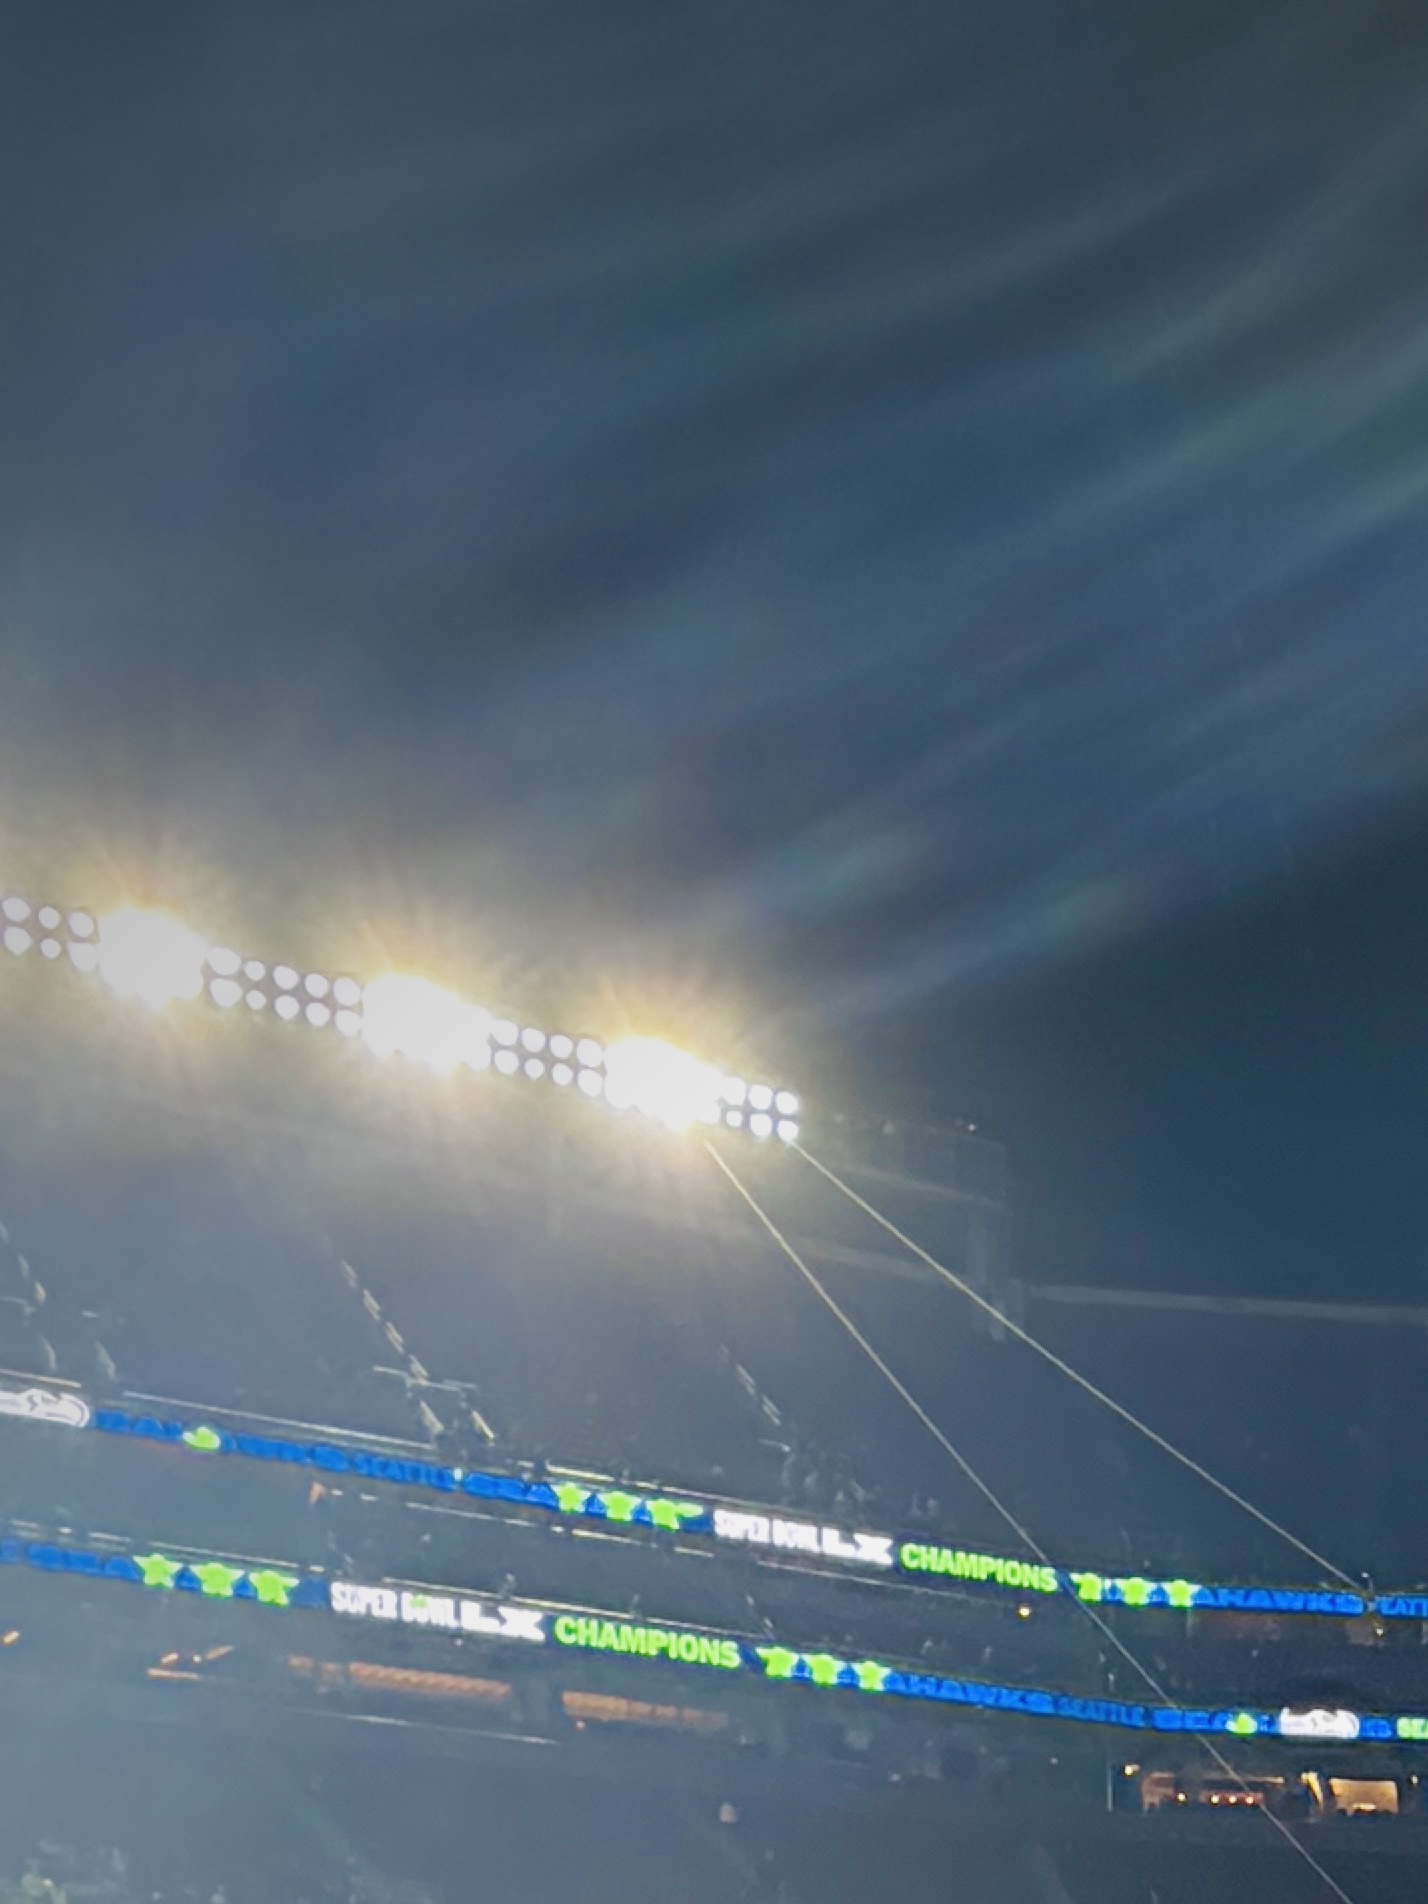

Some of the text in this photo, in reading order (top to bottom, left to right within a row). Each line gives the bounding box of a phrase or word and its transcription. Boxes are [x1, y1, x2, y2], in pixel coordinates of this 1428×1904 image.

[822, 1527, 894, 1567] LX
[899, 1543, 1060, 1594] CHAMPIONS
[330, 1581, 397, 1620] SUPER
[460, 1600, 546, 1643] LX
[554, 1612, 742, 1670] CHAMPIONS
